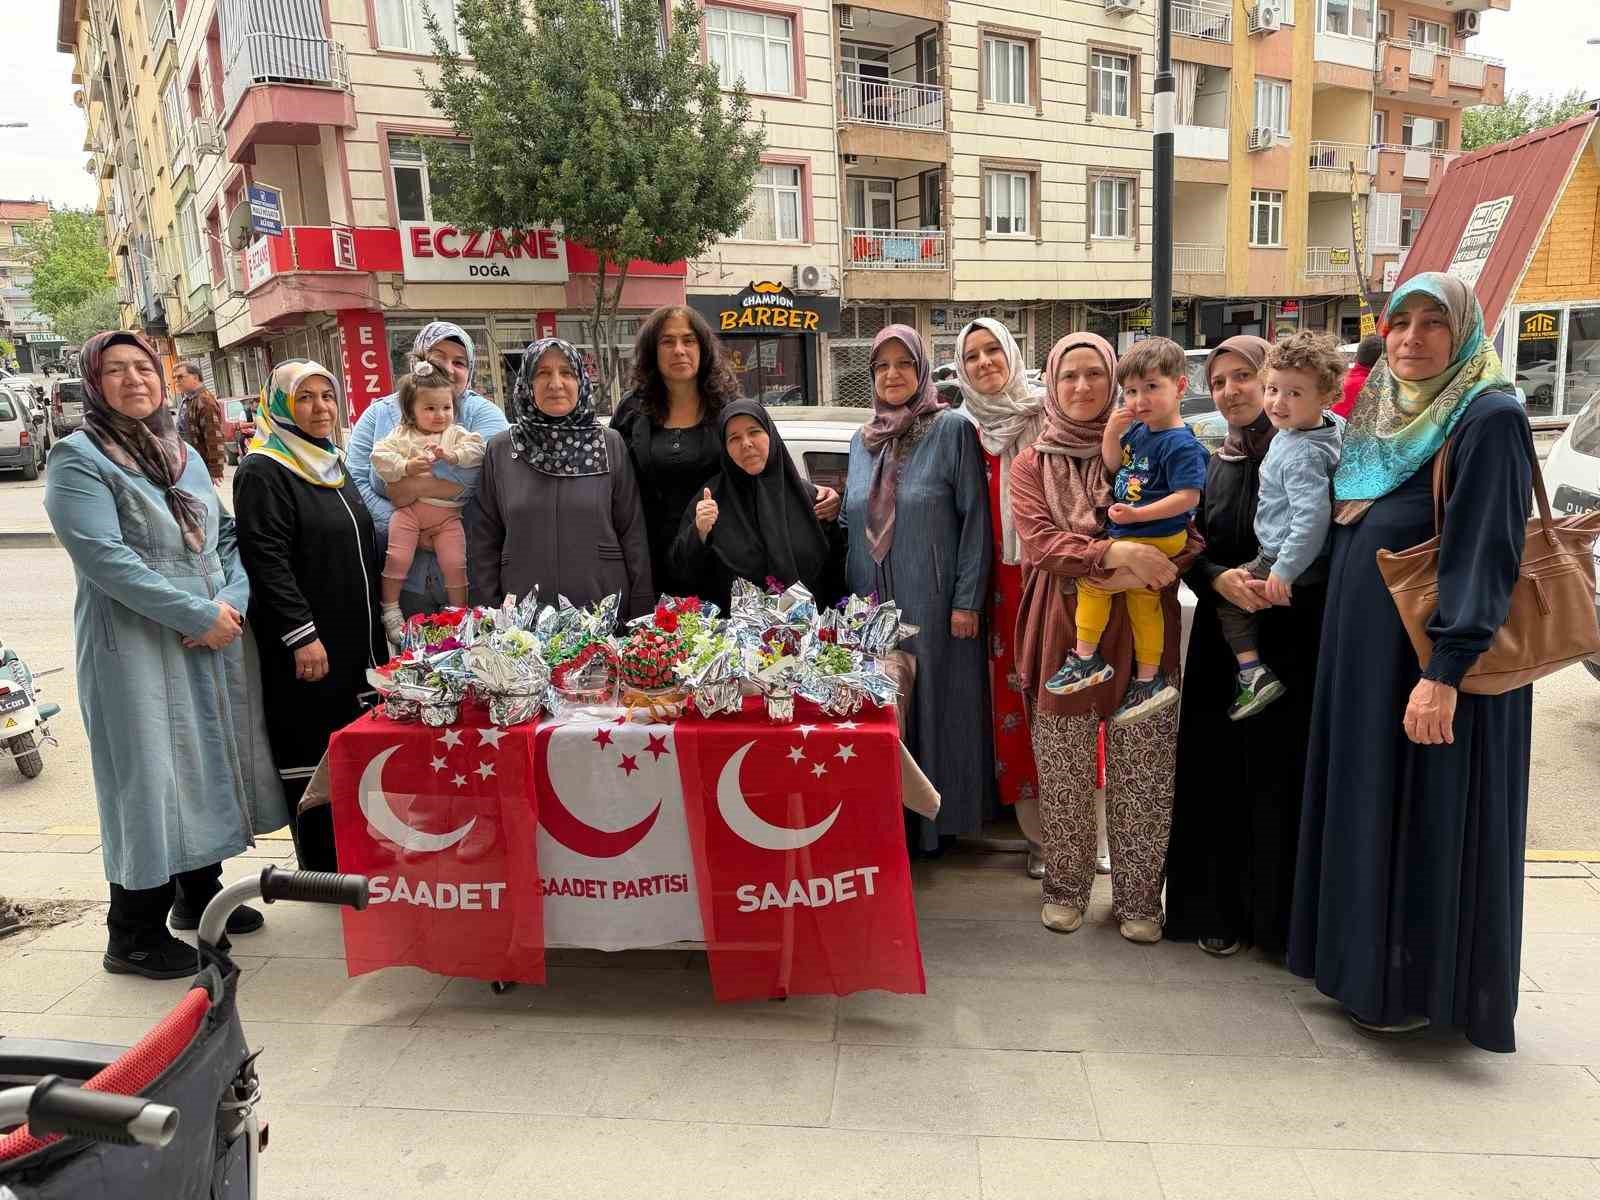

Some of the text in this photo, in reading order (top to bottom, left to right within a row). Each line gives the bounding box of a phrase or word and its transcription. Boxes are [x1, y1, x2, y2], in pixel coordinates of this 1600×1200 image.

[410, 225, 559, 259] ECZANE
[469, 263, 510, 277] DOĞA
[742, 295, 793, 307] CHAMPION
[720, 307, 819, 330] BARBER
[340, 326, 357, 428] ECZA
[360, 326, 381, 405] ECZ
[368, 876, 507, 910] SAADET
[535, 874, 689, 899] SAADET PARTİSİ
[736, 866, 880, 913] SAADET
